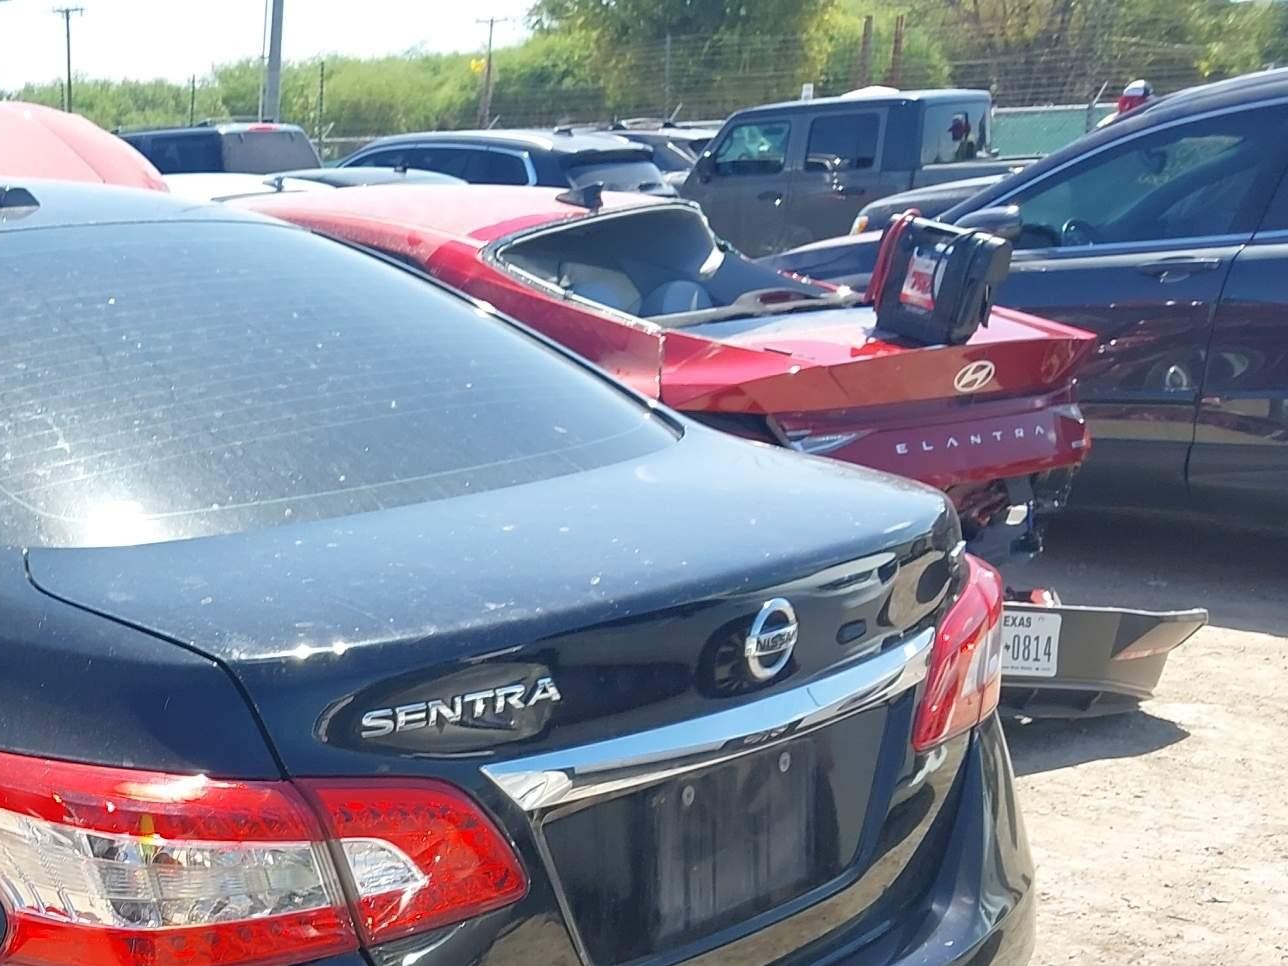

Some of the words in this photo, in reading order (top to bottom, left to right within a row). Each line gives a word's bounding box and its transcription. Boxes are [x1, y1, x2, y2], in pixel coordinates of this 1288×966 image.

[895, 424, 1045, 455] ELANTRA
[1002, 615, 1032, 628] EXAS
[1011, 634, 1052, 662] 0814
[361, 677, 562, 738] SENTRA
